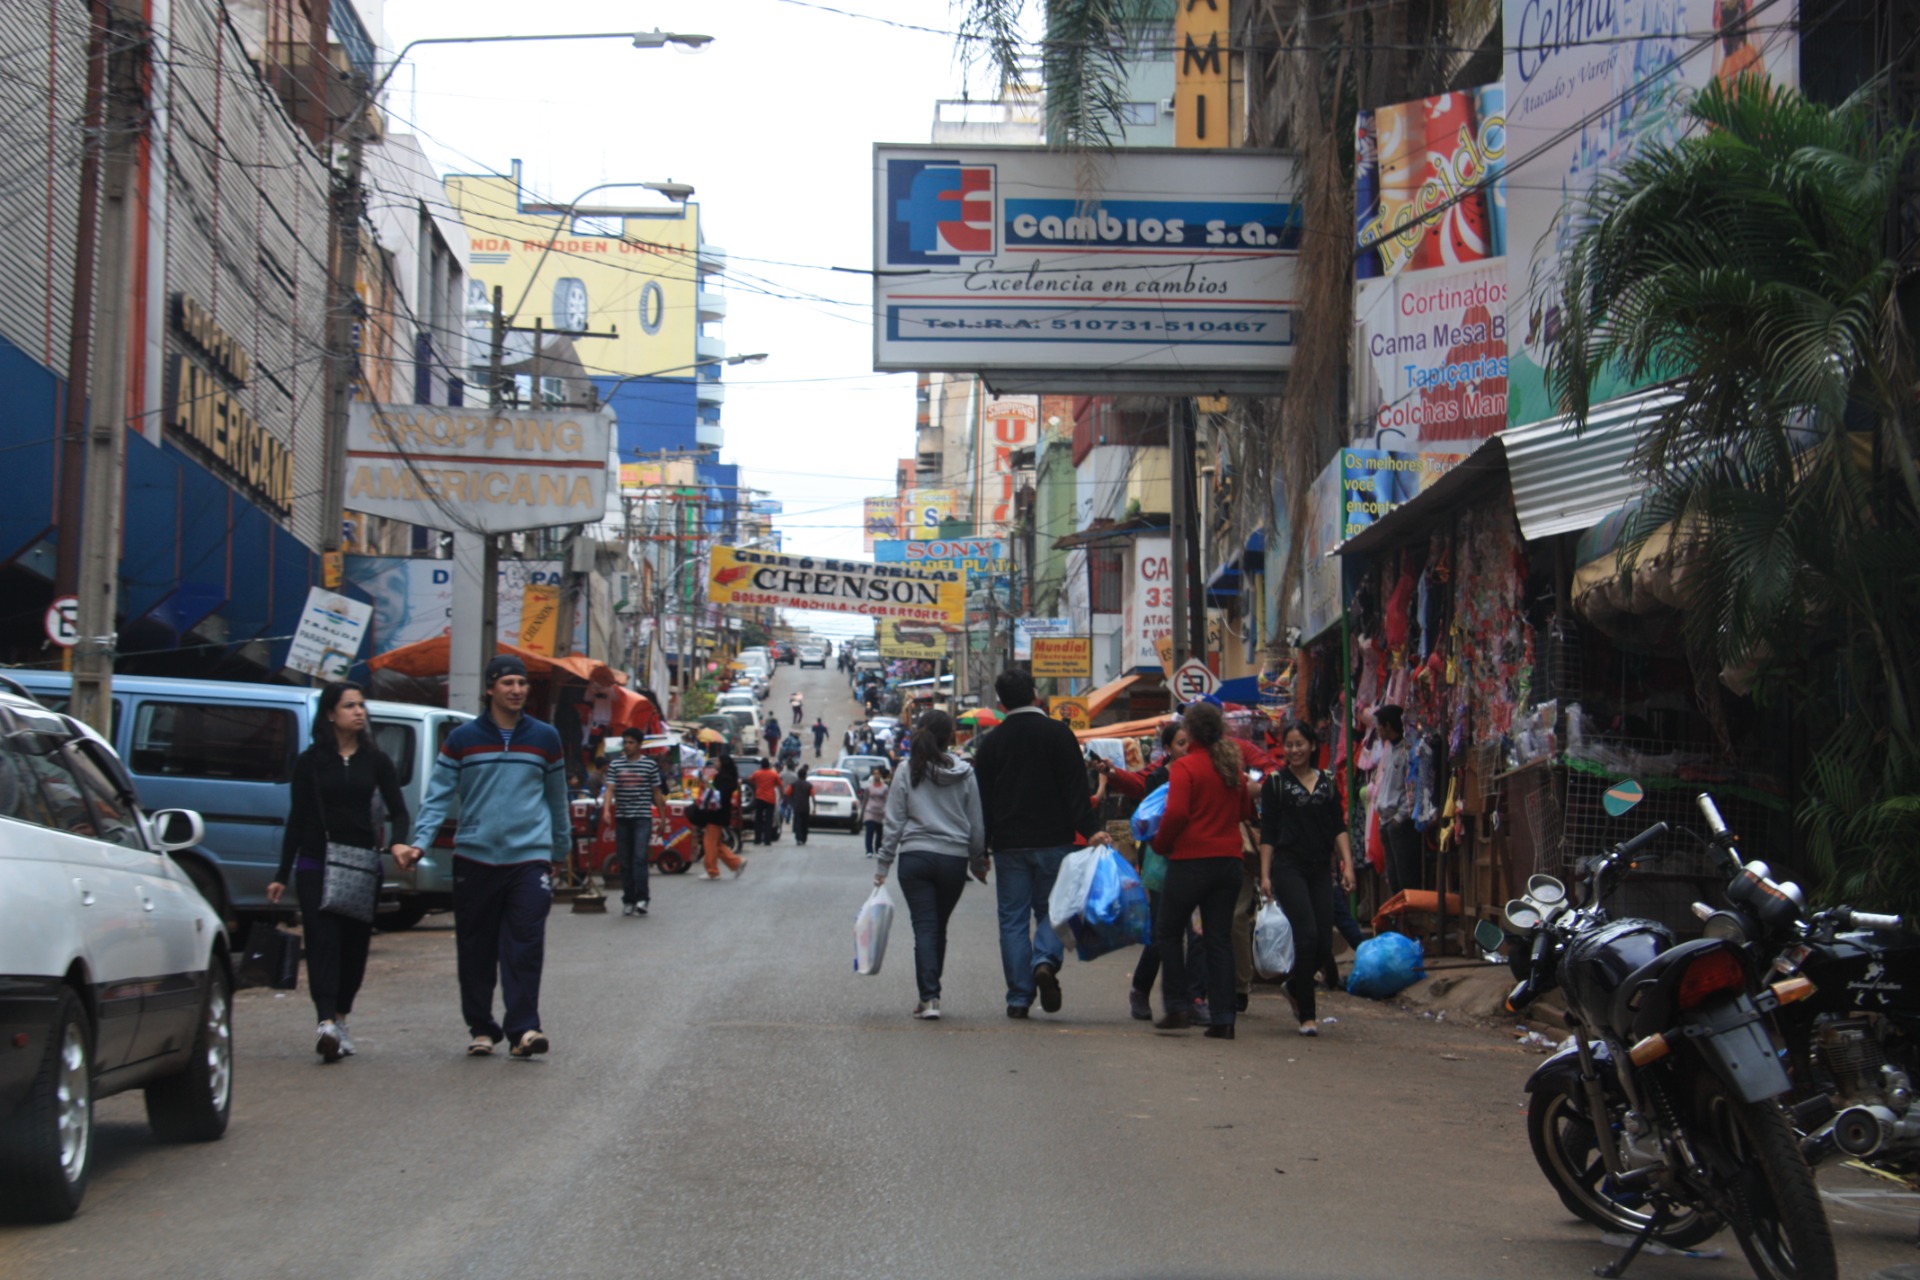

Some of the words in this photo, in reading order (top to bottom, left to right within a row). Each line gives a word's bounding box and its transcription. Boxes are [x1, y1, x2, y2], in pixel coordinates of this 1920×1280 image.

[1566, 76, 1575, 99] y
[1013, 210, 1184, 244] cambios
[1206, 219, 1279, 246] s.a.
[471, 239, 511, 252] NDA
[964, 259, 1093, 293] Excelencia
[1102, 280, 1128, 293] en
[1135, 263, 1228, 294] cambios
[1052, 318, 1268, 334] 510731-510467
[1371, 333, 1426, 357] Cama
[1434, 323, 1486, 348] Mesa
[1404, 353, 1509, 391] Tapiçarias
[1378, 398, 1457, 428] Colchas
[176, 356, 293, 513] AMERICANA
[369, 411, 584, 453] SHOPPING
[1345, 454, 1362, 469] Os
[1366, 455, 1424, 472] melhores
[350, 465, 594, 510] AMERICANA
[906, 542, 992, 558] SONY
[1141, 557, 1171, 580] CA
[753, 568, 939, 604] CHENSON
[1034, 640, 1087, 652] Mundial
